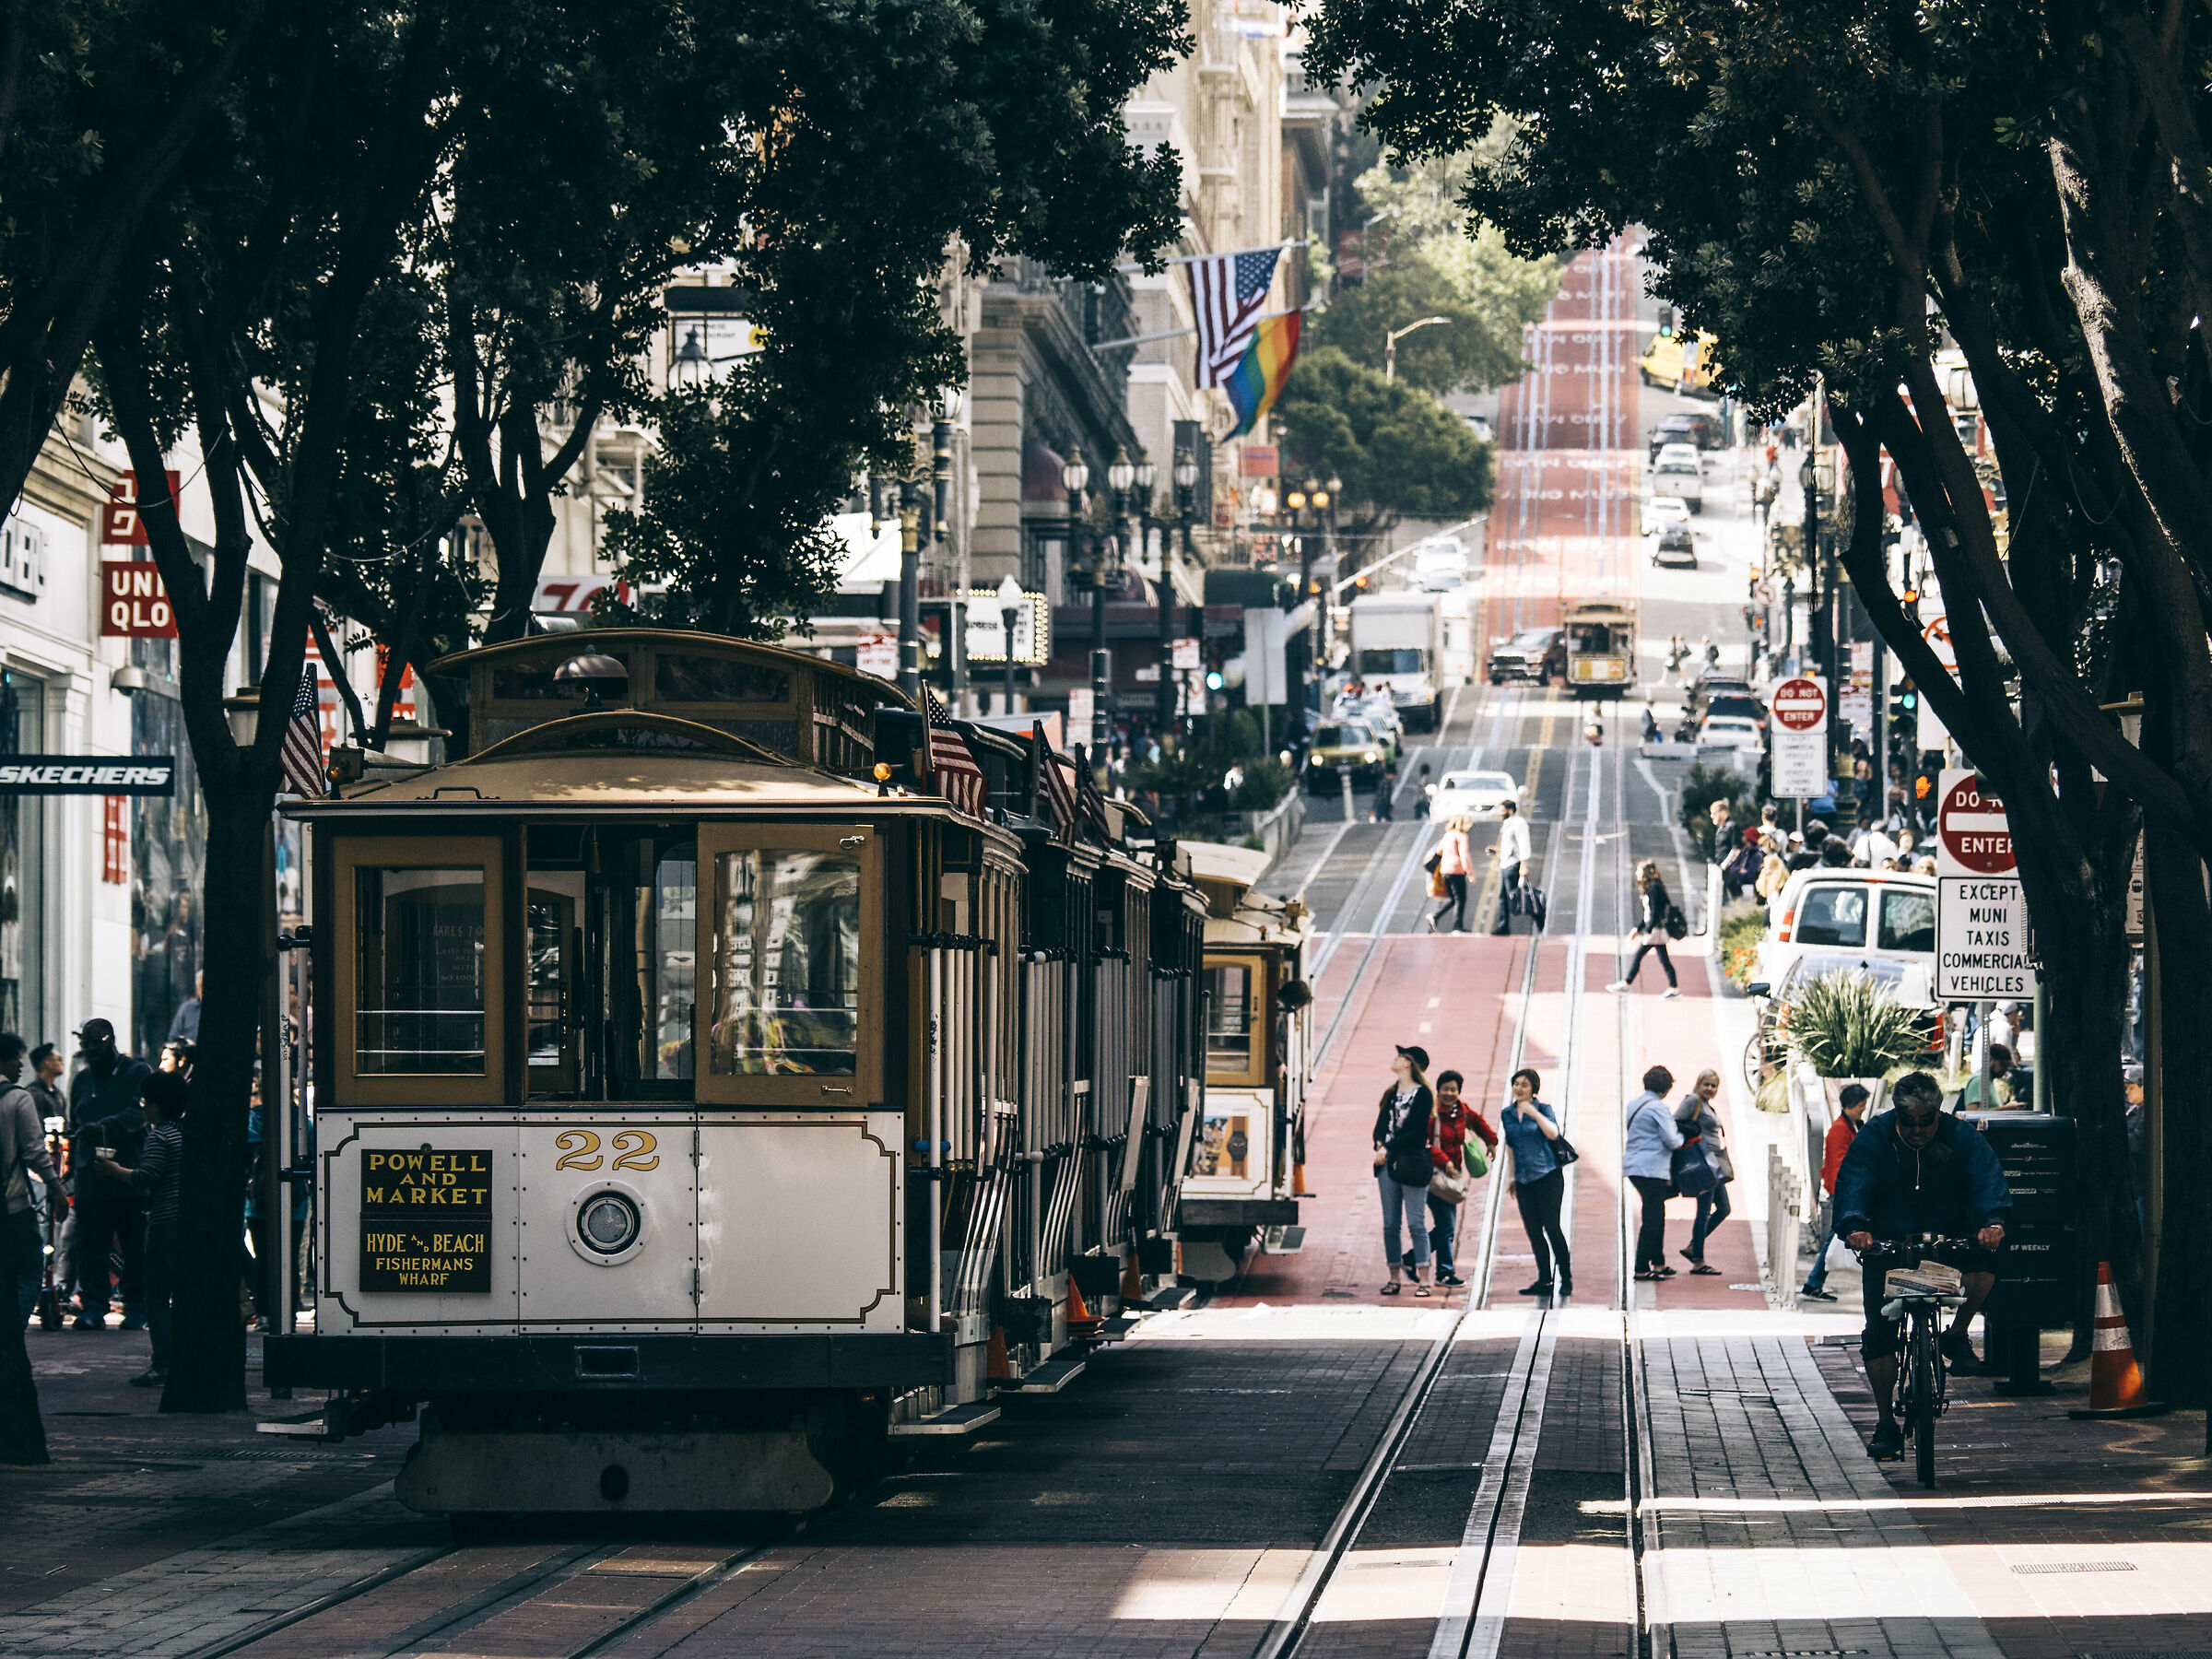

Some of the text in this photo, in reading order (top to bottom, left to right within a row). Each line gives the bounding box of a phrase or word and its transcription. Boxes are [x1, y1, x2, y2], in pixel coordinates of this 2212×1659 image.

[112, 571, 165, 598] UNI
[111, 601, 170, 632] QLO
[1780, 687, 1818, 699] DO NOT
[1783, 712, 1815, 722] ENTER
[0, 765, 171, 785] SKECHERS
[1955, 791, 1981, 807] DO
[1959, 884, 2018, 901] EXCEPT
[1970, 908, 2007, 924] MUNI
[1966, 930, 2010, 947] TAXIS
[1950, 975, 2024, 993] VEHICLES
[555, 1129, 660, 1172] 22
[369, 1153, 487, 1172] POWELL
[399, 1172, 457, 1185] AND
[366, 1186, 488, 1205] MARKET
[366, 1233, 485, 1253] HYDE AND BEACH
[375, 1257, 474, 1271] FISHERMANS
[399, 1272, 450, 1286] WHARF
